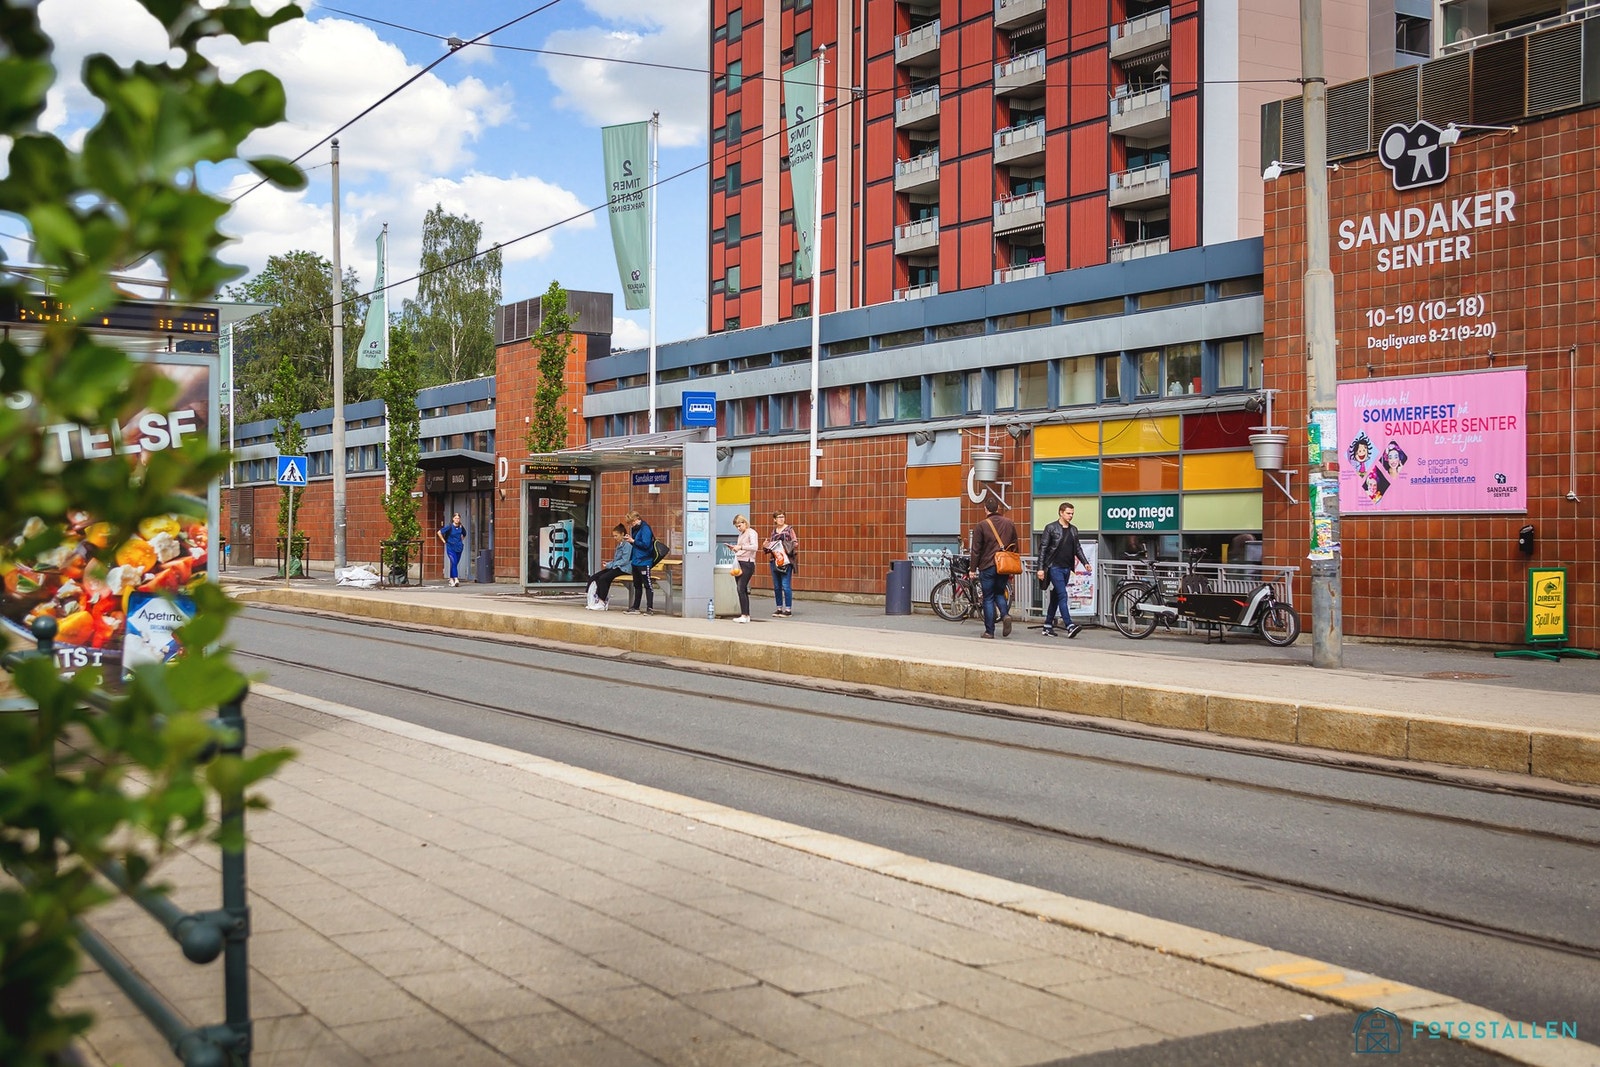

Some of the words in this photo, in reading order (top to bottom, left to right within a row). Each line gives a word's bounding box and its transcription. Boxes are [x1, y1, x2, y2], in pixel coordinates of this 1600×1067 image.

[1337, 190, 1516, 250] SANDAKER
[1376, 235, 1471, 272] SENTER
[1365, 304, 1415, 328] 10-19
[1418, 295, 1485, 324] (10-18)
[1367, 333, 1427, 350] Dagligvare
[1363, 404, 1456, 423] SOMMERFEST
[1385, 418, 1458, 436] SANDAKER
[1461, 416, 1517, 433] SENTER
[499, 457, 509, 483] D
[1417, 458, 1426, 466] Se
[1428, 458, 1457, 467] program
[1459, 457, 1469, 467] og
[1428, 466, 1448, 474] tilbud
[1450, 466, 1459, 475] på
[634, 473, 654, 483] Sandaker
[654, 474, 668, 482] senter
[1410, 475, 1476, 484] sandakersenter.no
[1107, 507, 1137, 521] coop
[1139, 506, 1174, 522] mega
